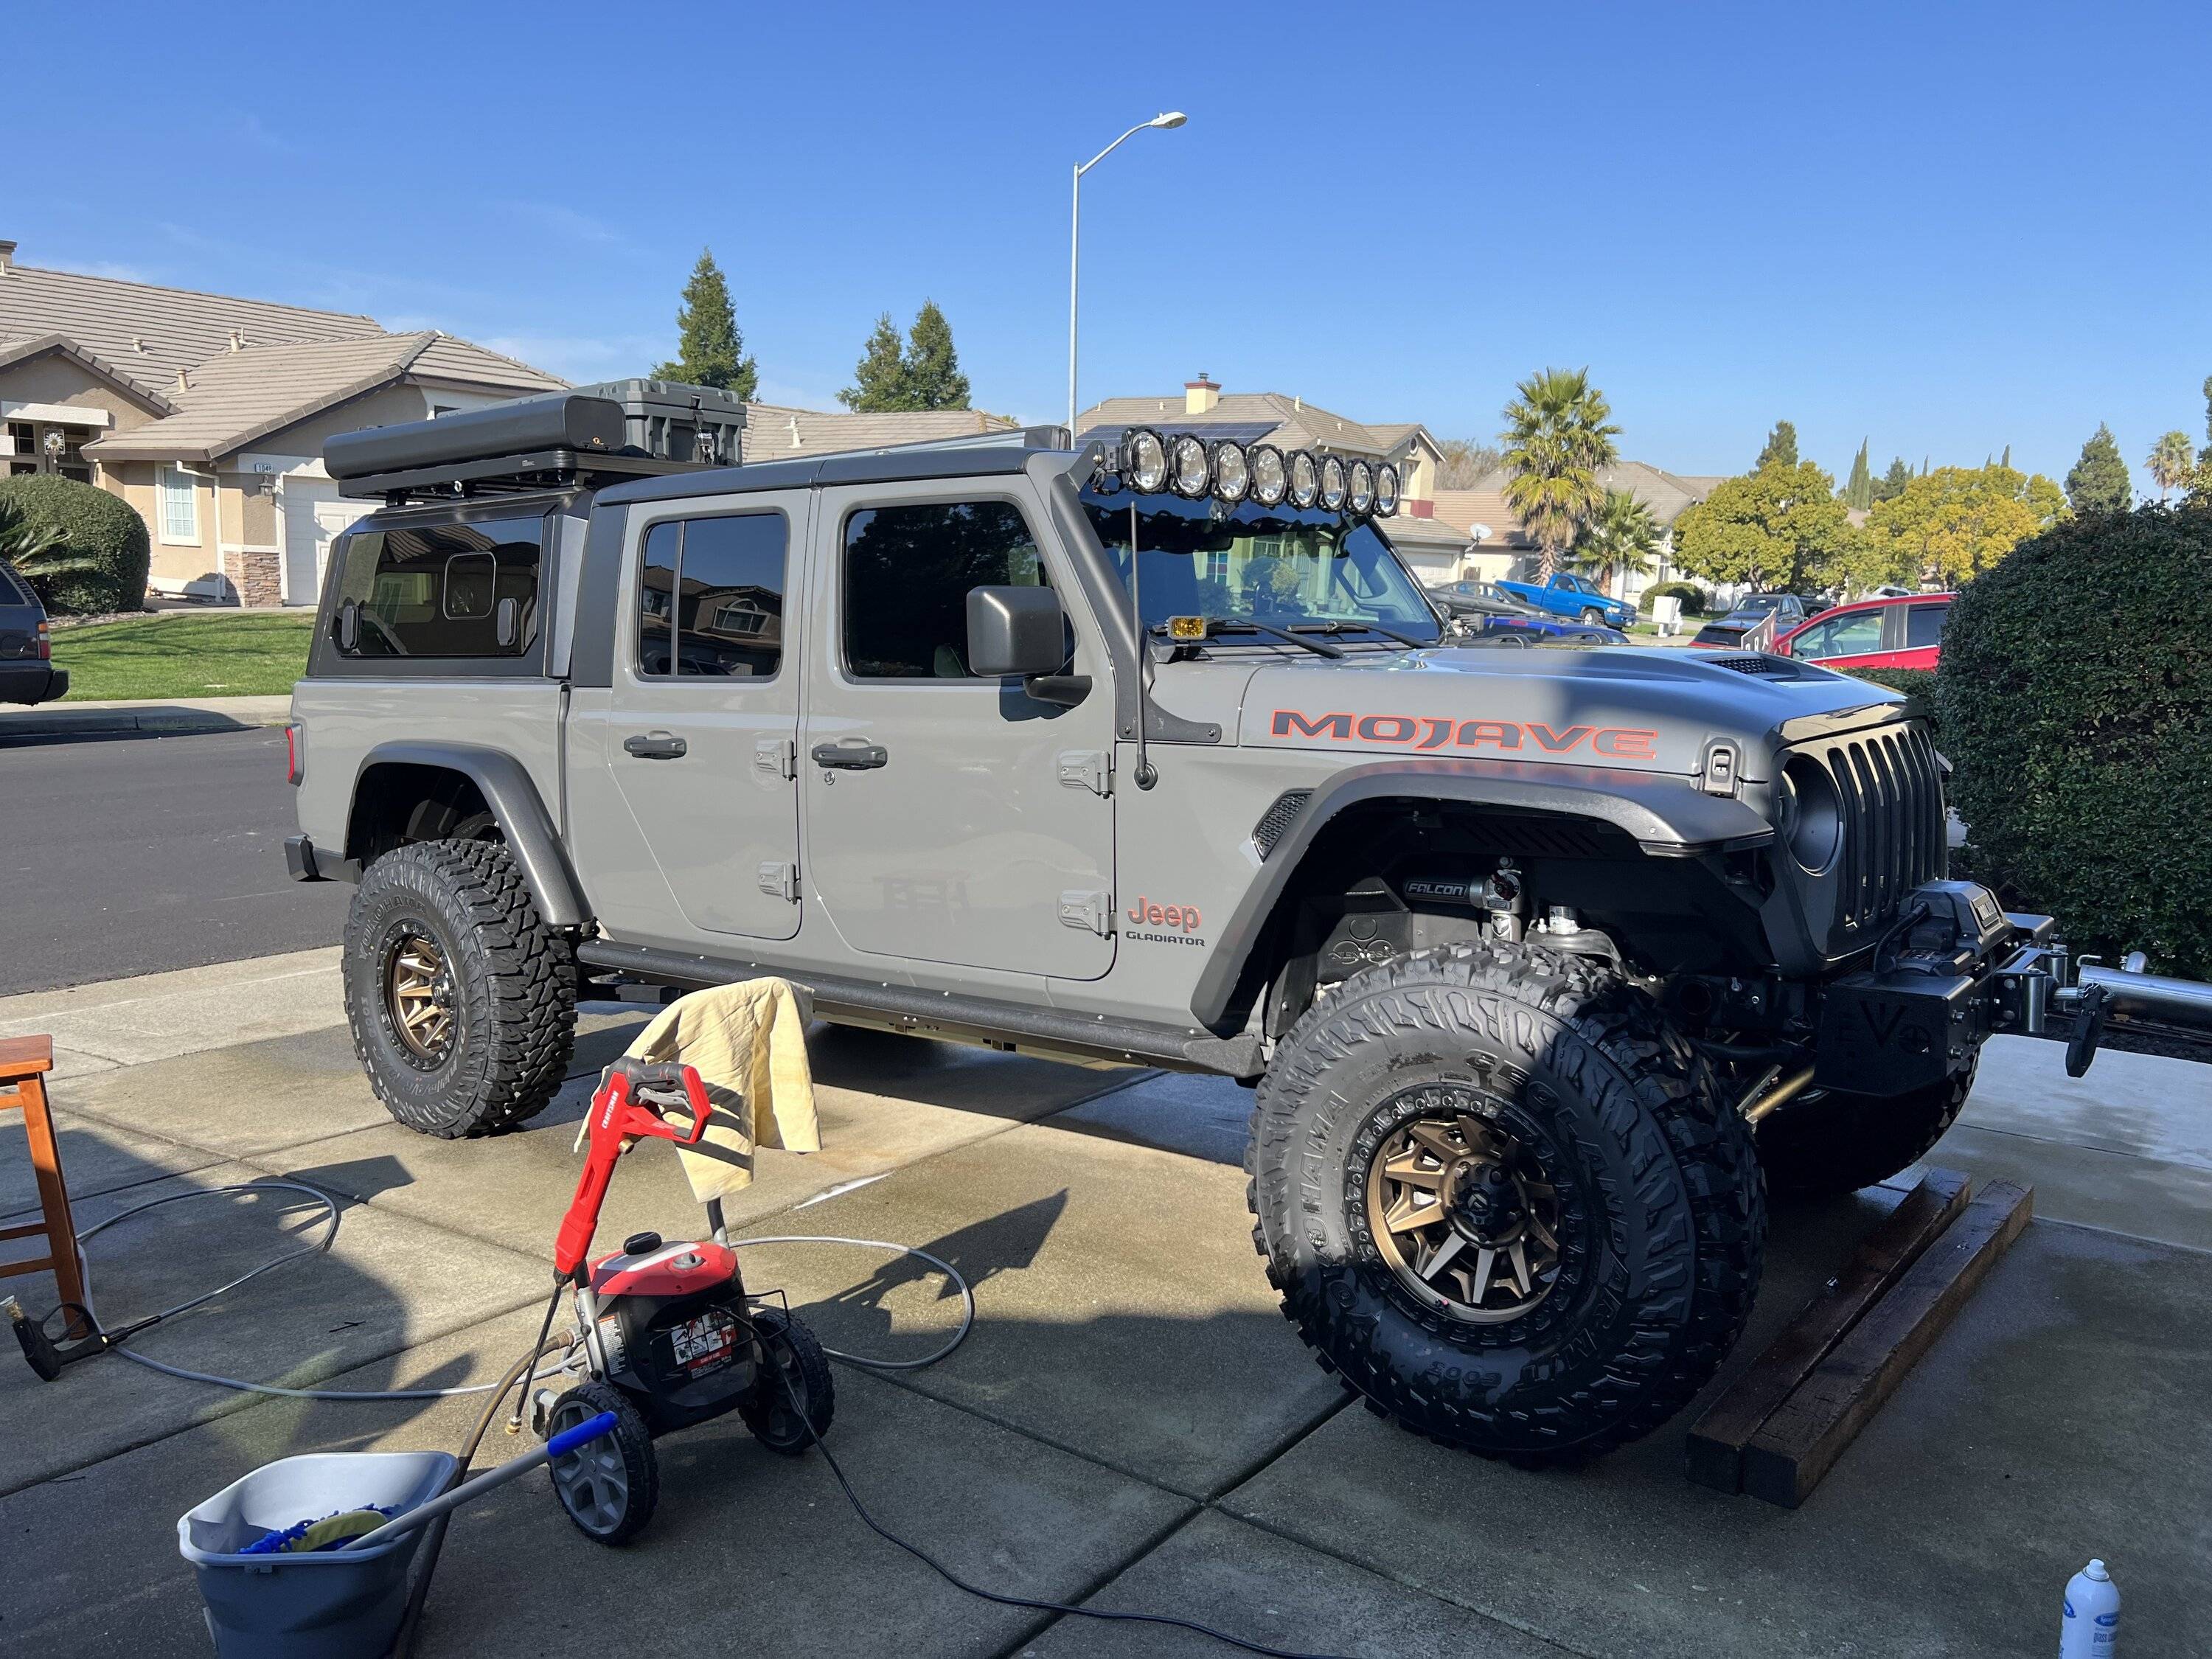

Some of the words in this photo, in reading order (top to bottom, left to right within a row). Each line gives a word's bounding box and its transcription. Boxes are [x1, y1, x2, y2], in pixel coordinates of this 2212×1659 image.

[1270, 709, 1659, 760] MOJAVE
[1407, 882, 1464, 897] FALCON
[358, 894, 428, 960] YOKOHAMA
[1127, 895, 1203, 933] Jeep
[1125, 931, 1206, 947] GLADIATOR
[601, 1090, 619, 1130] CRAFTSMAN
